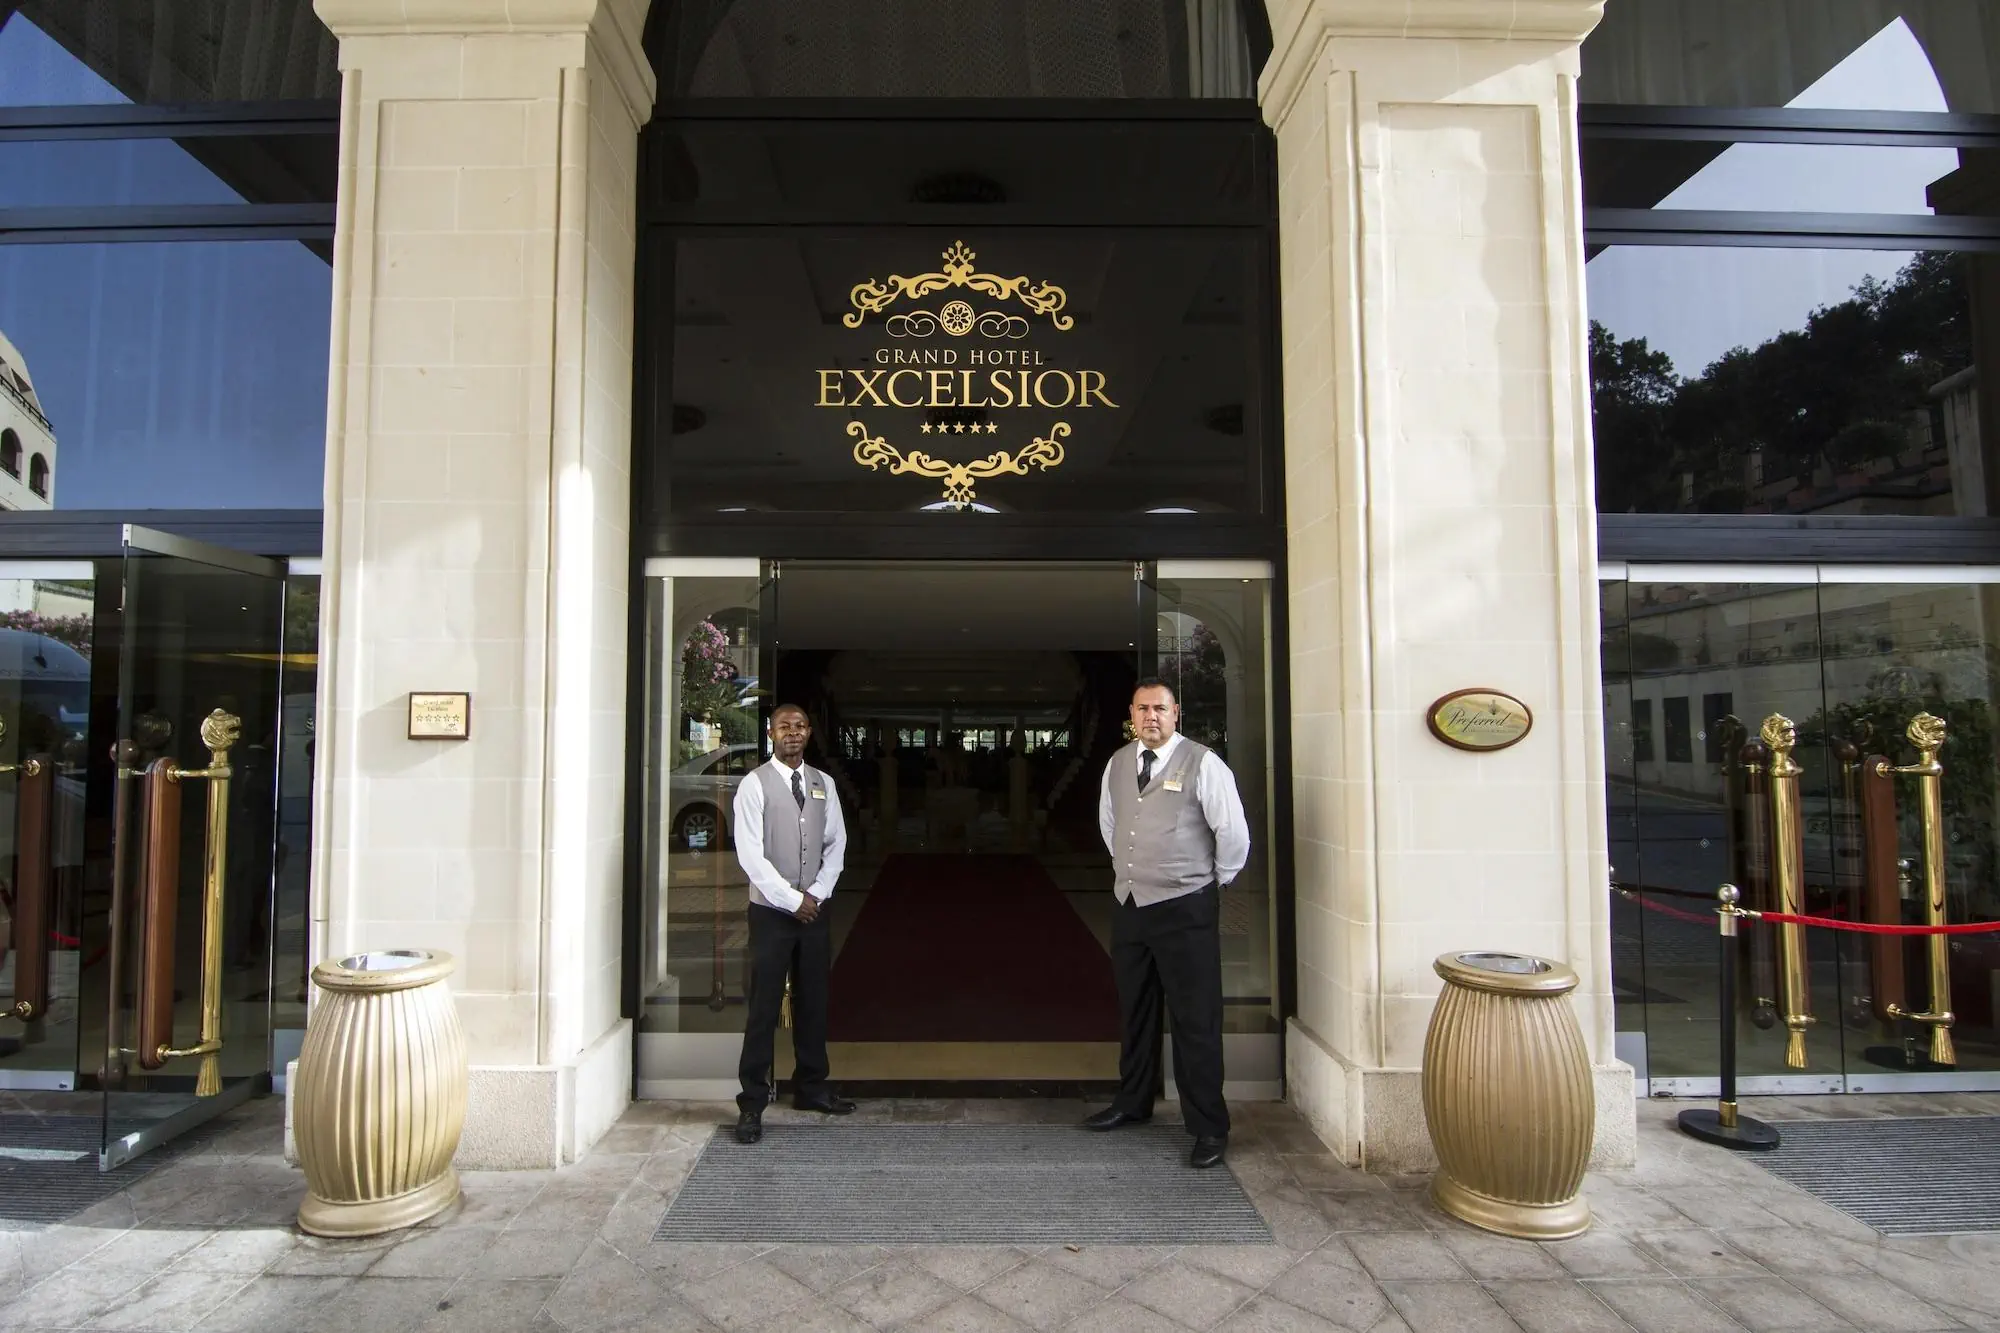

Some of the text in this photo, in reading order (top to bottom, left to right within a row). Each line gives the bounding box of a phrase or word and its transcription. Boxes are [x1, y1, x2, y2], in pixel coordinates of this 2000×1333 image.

[875, 348, 1045, 365] GRAND HOTEL
[814, 369, 1120, 408] EXCELSIOR
[1448, 708, 1512, 733] Preferred
